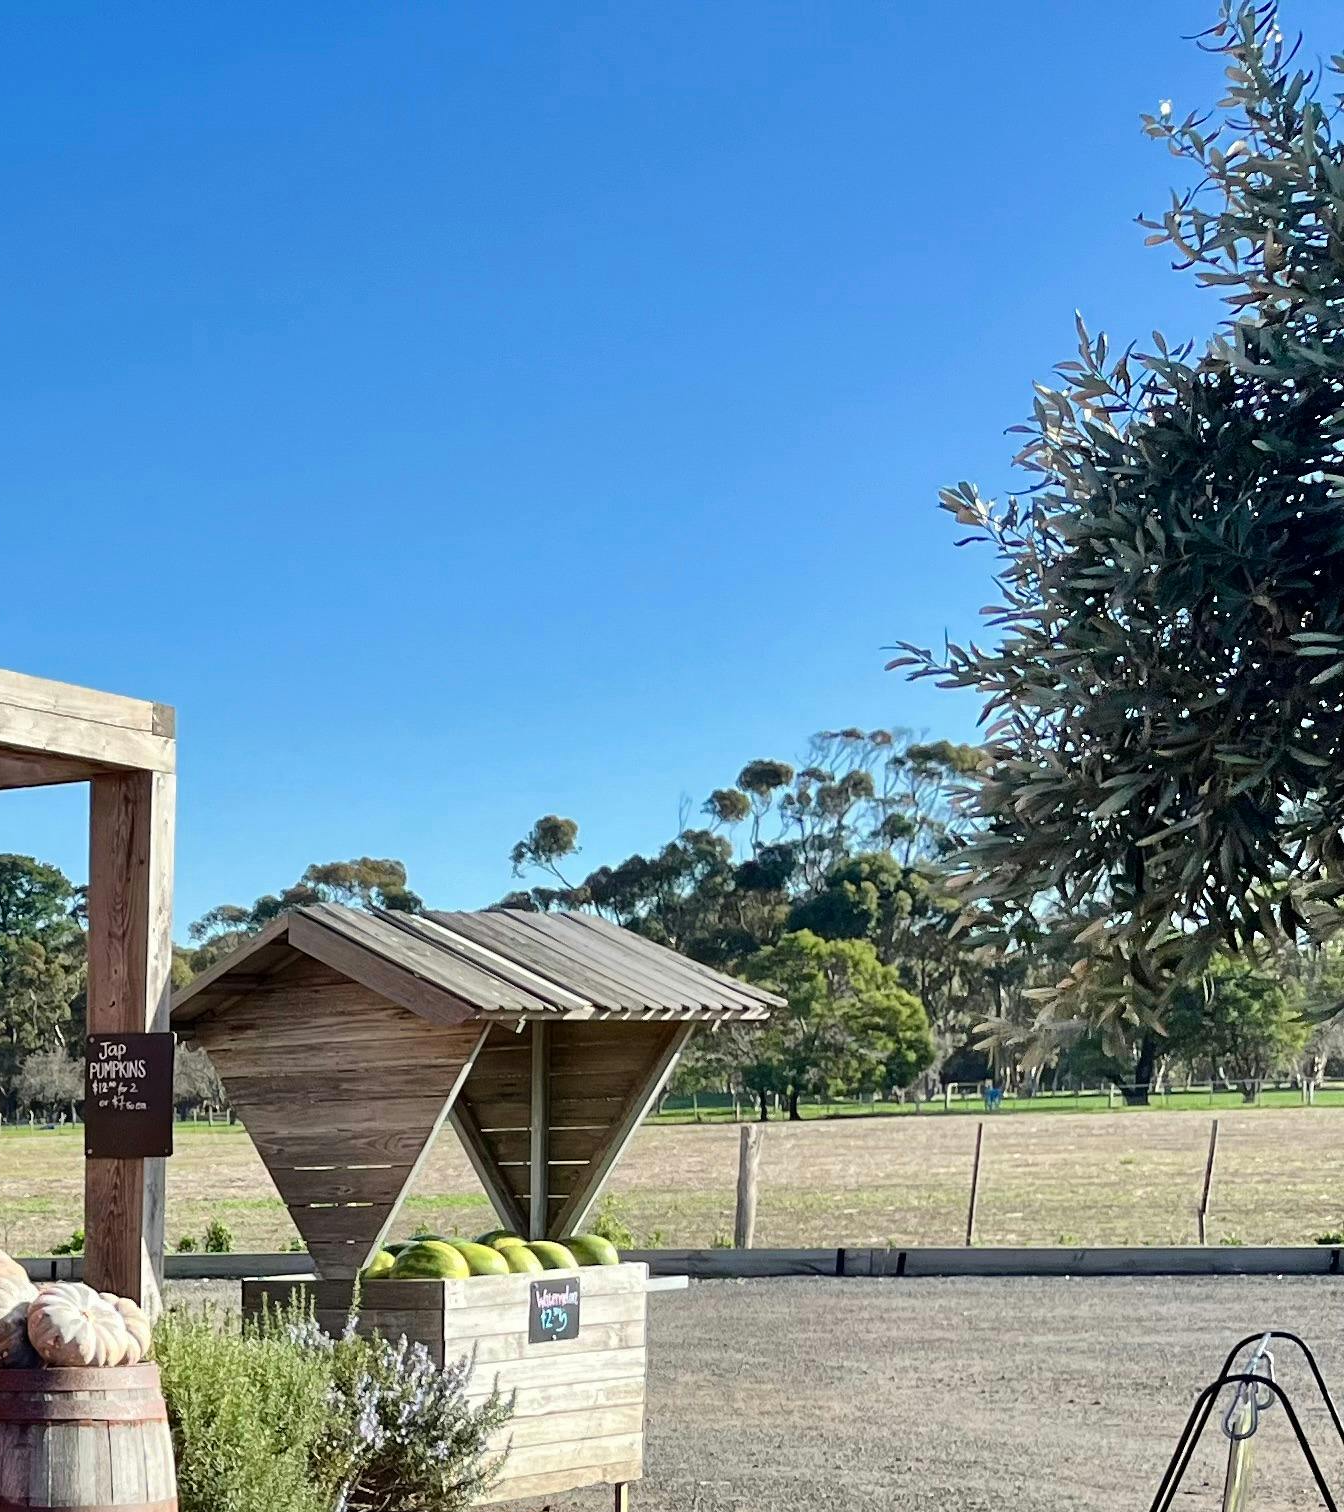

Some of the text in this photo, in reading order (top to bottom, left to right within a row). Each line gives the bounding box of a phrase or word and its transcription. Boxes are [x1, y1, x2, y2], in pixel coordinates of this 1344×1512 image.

[99, 1042, 126, 1060] Jap
[90, 1060, 145, 1079] PUMPKINS
[130, 1082, 139, 1093] 2
